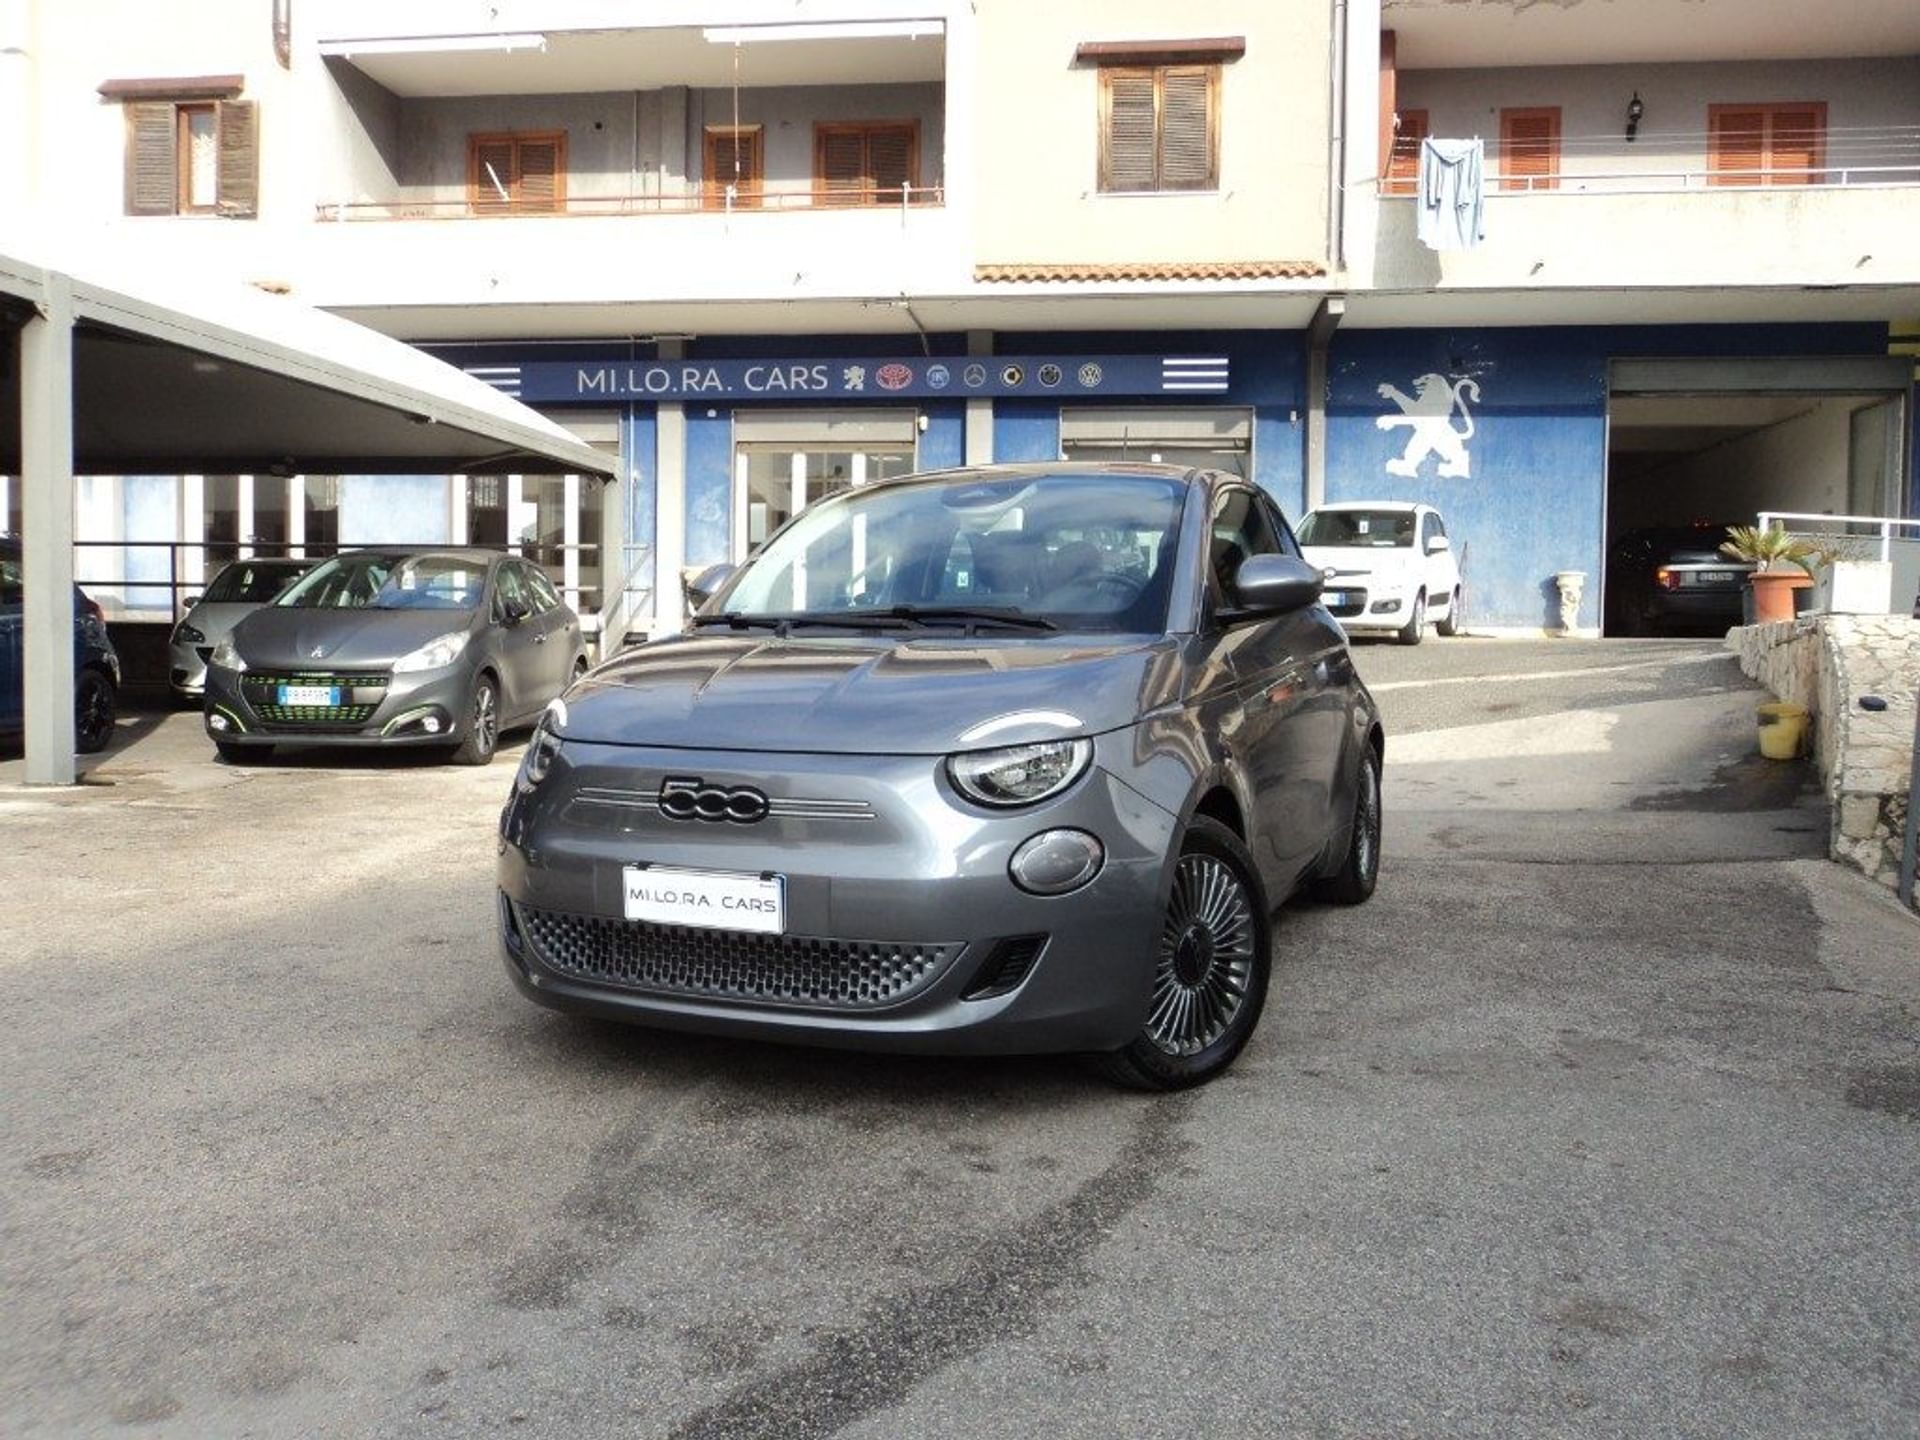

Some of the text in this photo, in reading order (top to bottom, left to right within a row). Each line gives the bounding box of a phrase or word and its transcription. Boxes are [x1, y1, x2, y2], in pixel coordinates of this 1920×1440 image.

[577, 365, 829, 393] MI.LO.RA. CARS
[658, 776, 770, 824] 500
[721, 895, 776, 913] CARS
